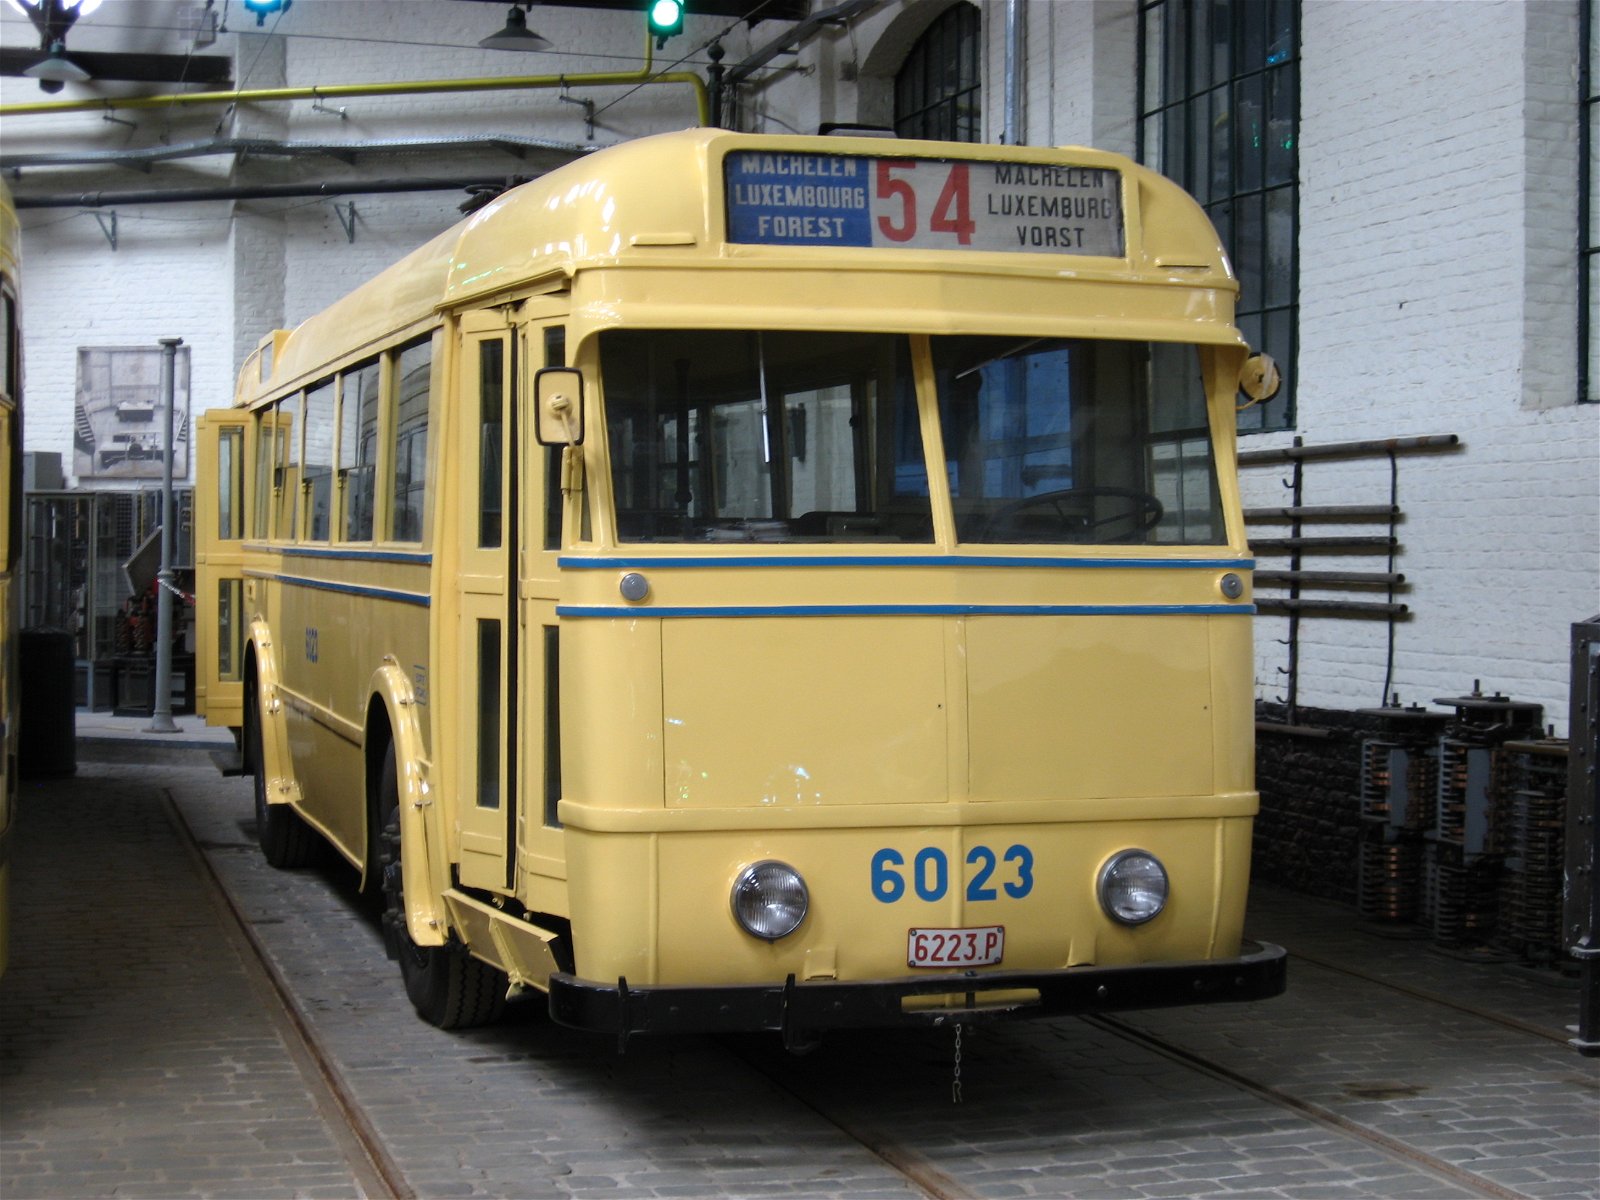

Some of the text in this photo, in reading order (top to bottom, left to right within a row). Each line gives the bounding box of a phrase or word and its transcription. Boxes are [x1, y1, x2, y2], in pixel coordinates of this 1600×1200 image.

[741, 154, 857, 178] MACHELEN
[994, 164, 1104, 188] MACHELEN
[735, 183, 866, 210] LUXEMBOURG
[876, 159, 976, 246] 54
[987, 193, 1112, 220] LUXEMBURG
[758, 215, 845, 239] FOREST
[1016, 225, 1085, 249] VORST
[871, 844, 1034, 904] 6023
